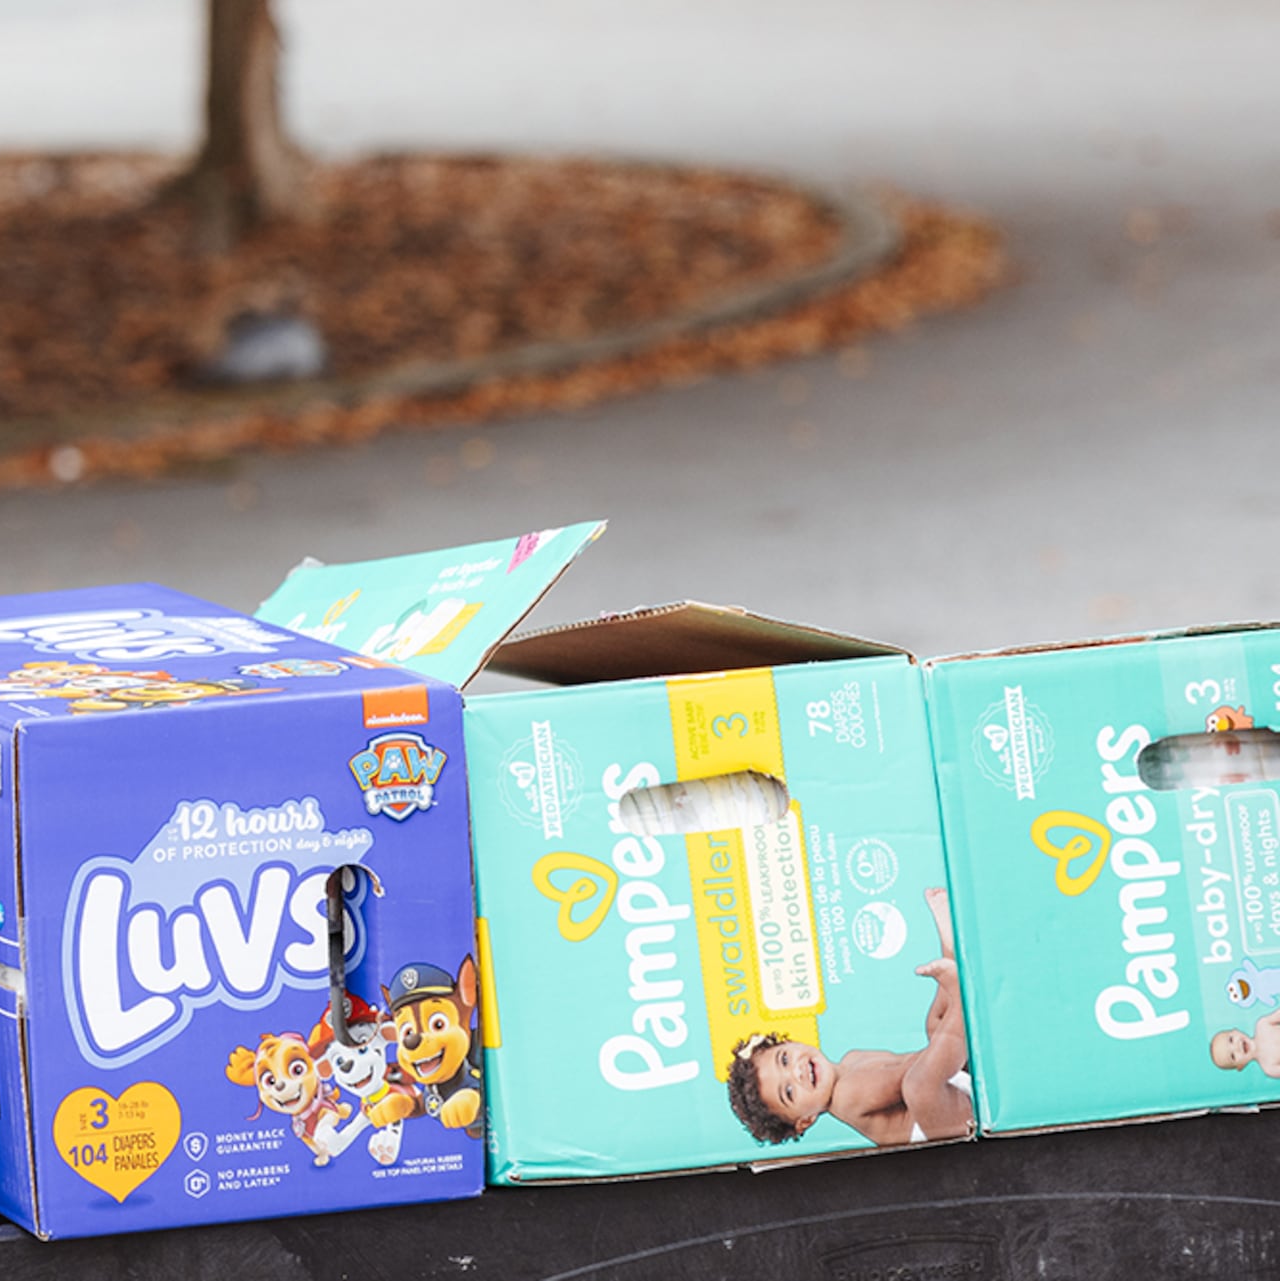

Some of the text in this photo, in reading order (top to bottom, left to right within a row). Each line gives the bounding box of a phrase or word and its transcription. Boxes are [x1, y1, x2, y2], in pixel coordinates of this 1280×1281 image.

[1185, 678, 1221, 705] 3
[711, 712, 749, 738] 3
[806, 699, 833, 737] 78
[830, 689, 850, 743] DIAPERS
[844, 681, 866, 748] COUCHES
[1009, 692, 1031, 794] PEDIATRICIAN
[349, 747, 447, 791] PAW
[536, 726, 560, 832] PEDIATRICIAN
[375, 789, 425, 803] PATROL
[176, 804, 218, 841] 12
[225, 801, 320, 837] hours
[1257, 808, 1278, 867] nights
[153, 847, 177, 862] OF
[183, 838, 292, 860] PROTECTION
[1094, 723, 1190, 1040] Pampers
[1186, 785, 1233, 964] baby-dry
[1263, 872, 1279, 886] &
[775, 815, 811, 1000] skin protection
[810, 824, 841, 984] protection de la peau
[831, 905, 846, 932] 100
[703, 833, 751, 1016] swaddler
[89, 1098, 109, 1129] 3
[68, 1132, 156, 1167] 104 DIAPERS
[216, 1128, 286, 1144] MONEY BACK
[218, 1169, 235, 1180] NO
